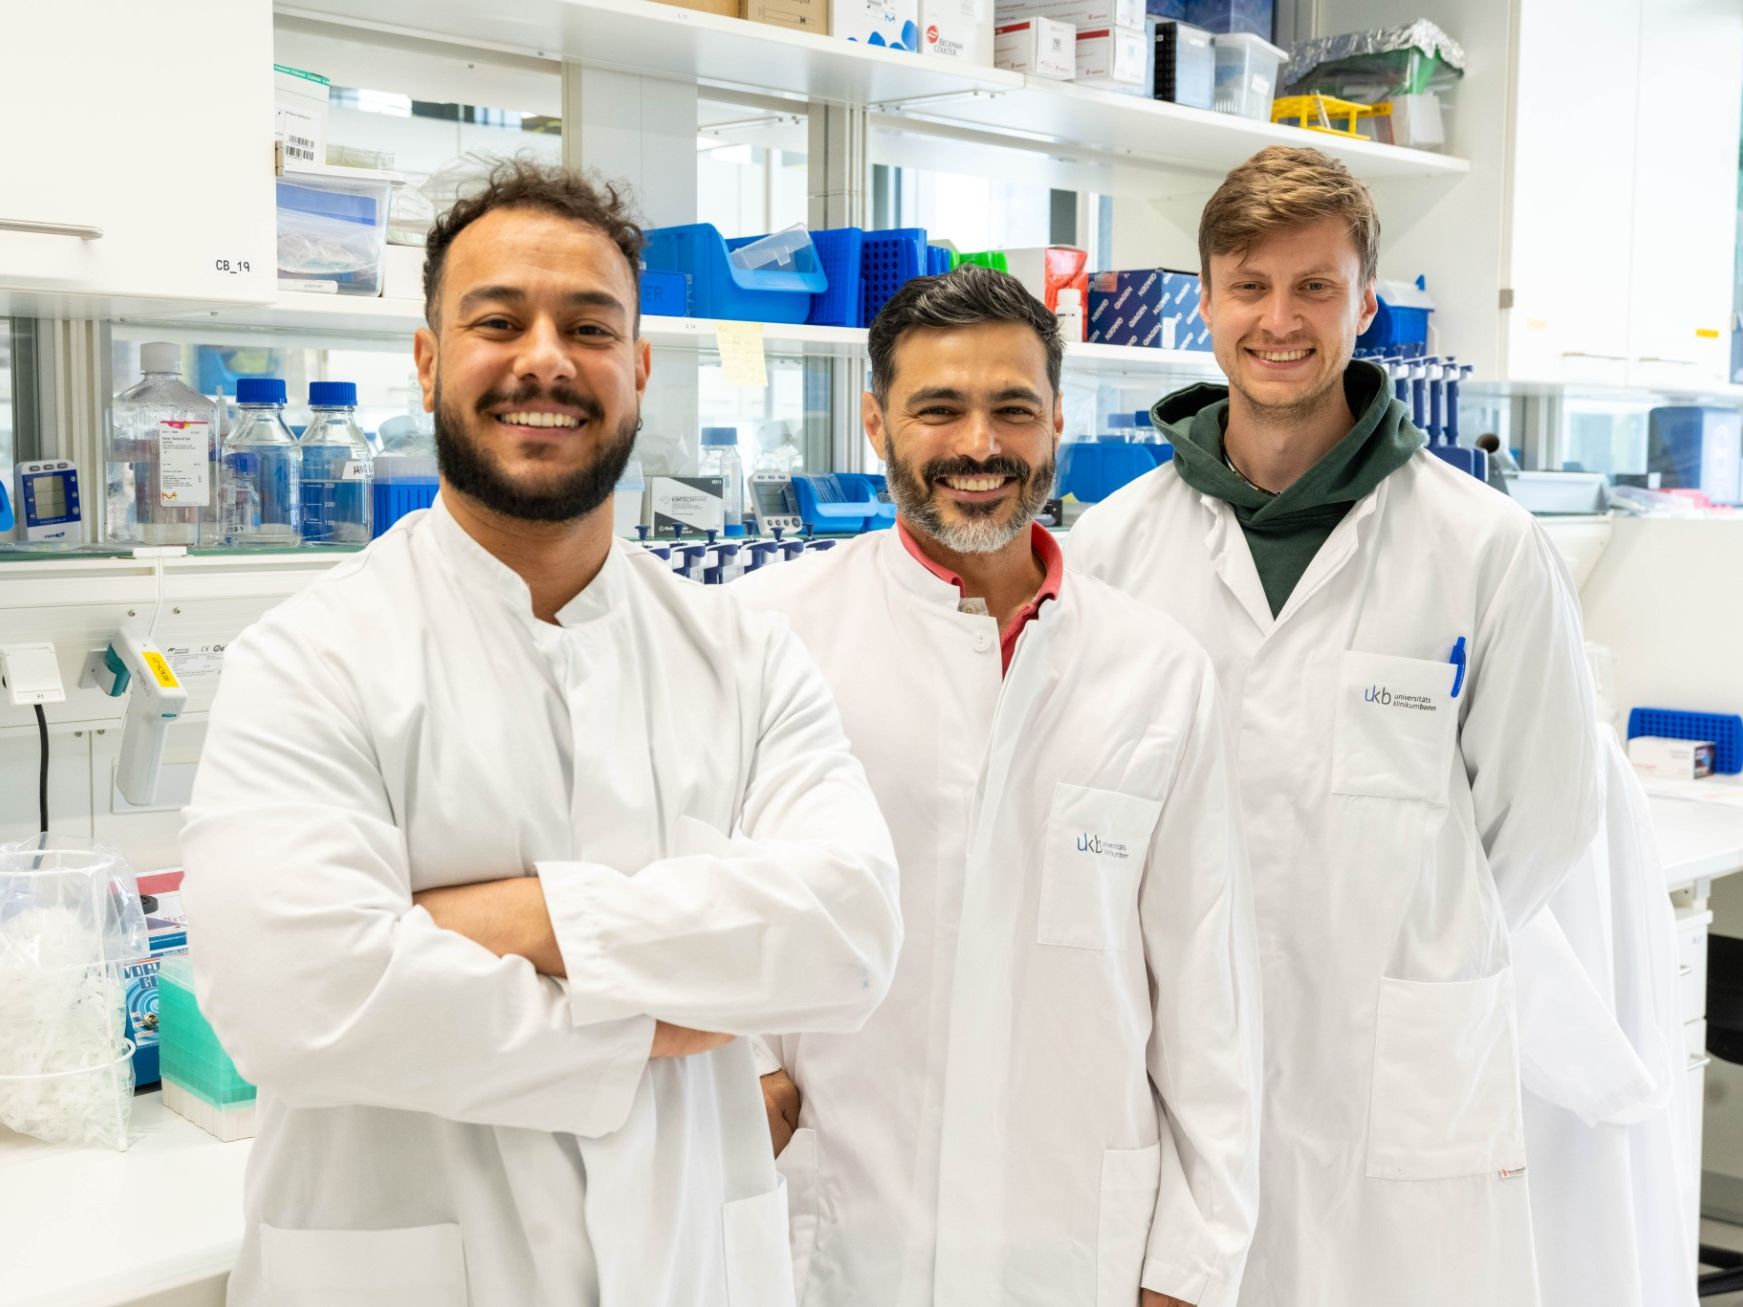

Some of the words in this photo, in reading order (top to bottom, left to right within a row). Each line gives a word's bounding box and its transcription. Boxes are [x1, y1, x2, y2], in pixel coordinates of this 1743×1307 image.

[216, 259, 250, 274] CB_19
[1138, 272, 1157, 297] QIAGEN
[1114, 285, 1133, 310] QIAGEN
[1091, 298, 1109, 322] QIAGEN
[1128, 304, 1148, 328] QIAGEN
[1105, 316, 1123, 340] QIAGEN
[1143, 321, 1161, 346] QIAGEN
[1364, 685, 1391, 705] ukb
[1393, 700, 1436, 711] klinikumbonn
[1394, 694, 1432, 703] universitäts
[1077, 832, 1103, 854] ukb
